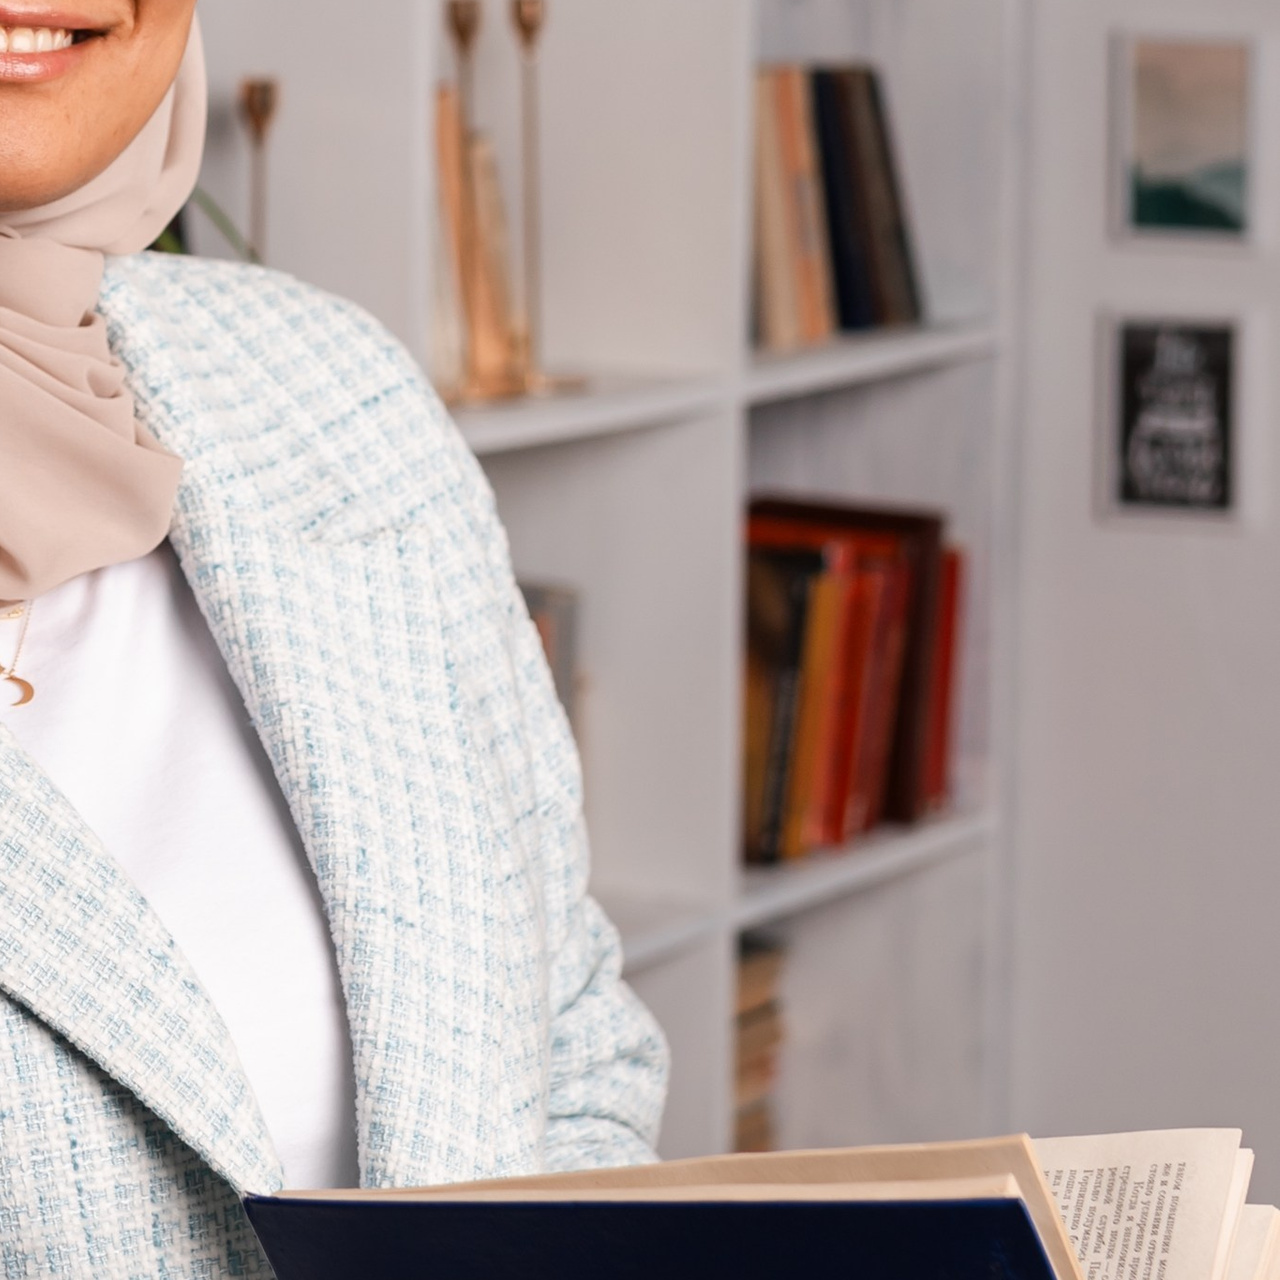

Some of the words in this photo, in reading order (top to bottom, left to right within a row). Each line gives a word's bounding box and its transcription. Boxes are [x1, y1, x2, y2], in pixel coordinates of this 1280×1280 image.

[1063, 1170, 1077, 1200] пошел
[1091, 1169, 1104, 1202] вольно
[1145, 1164, 1158, 1196] стояло
[1163, 1164, 1172, 1176] же
[1173, 1162, 1186, 1190] таком
[1071, 1170, 1094, 1230] Горпищенко
[1113, 1166, 1131, 1225] стрелкового
[1128, 1182, 1144, 1210] Когда
[1133, 1200, 1151, 1252] ускоренно
[1151, 1190, 1166, 1236] сознания
[1094, 1215, 1108, 1254] службы
[1106, 1230, 1118, 1259] полка
